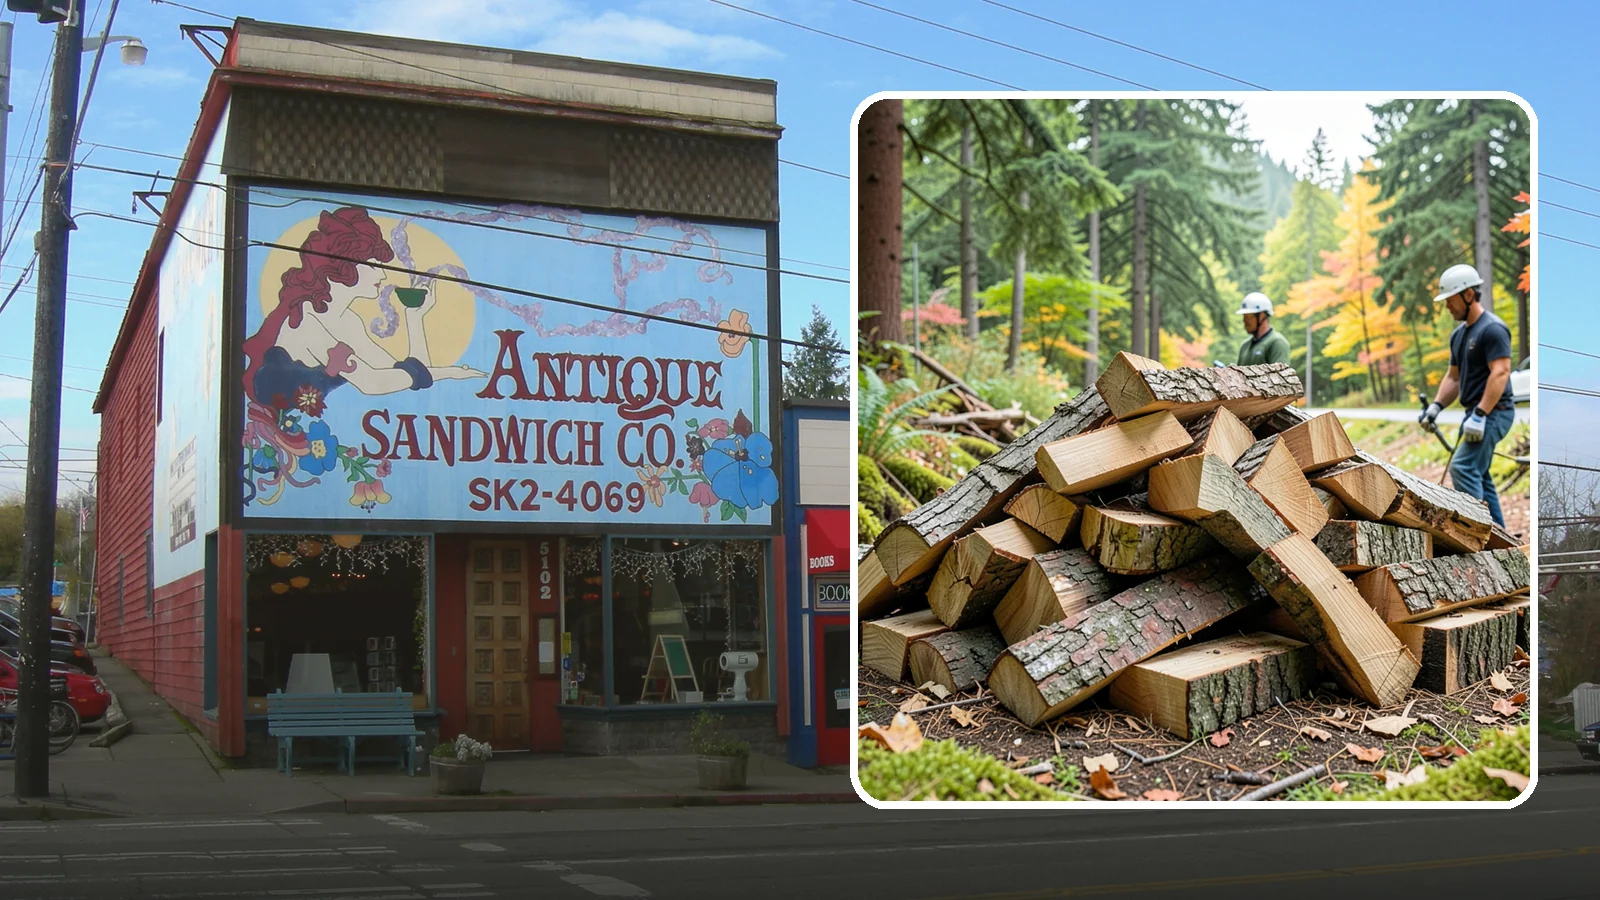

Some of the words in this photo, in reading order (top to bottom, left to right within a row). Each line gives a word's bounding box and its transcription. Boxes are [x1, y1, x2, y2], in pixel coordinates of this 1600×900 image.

[475, 329, 724, 421] ANTIQUE
[361, 408, 604, 467] SANDWICH
[617, 421, 685, 469] CO.
[468, 476, 646, 513] SK2-4069
[539, 542, 552, 600] 5102
[809, 555, 835, 569] BOOKS
